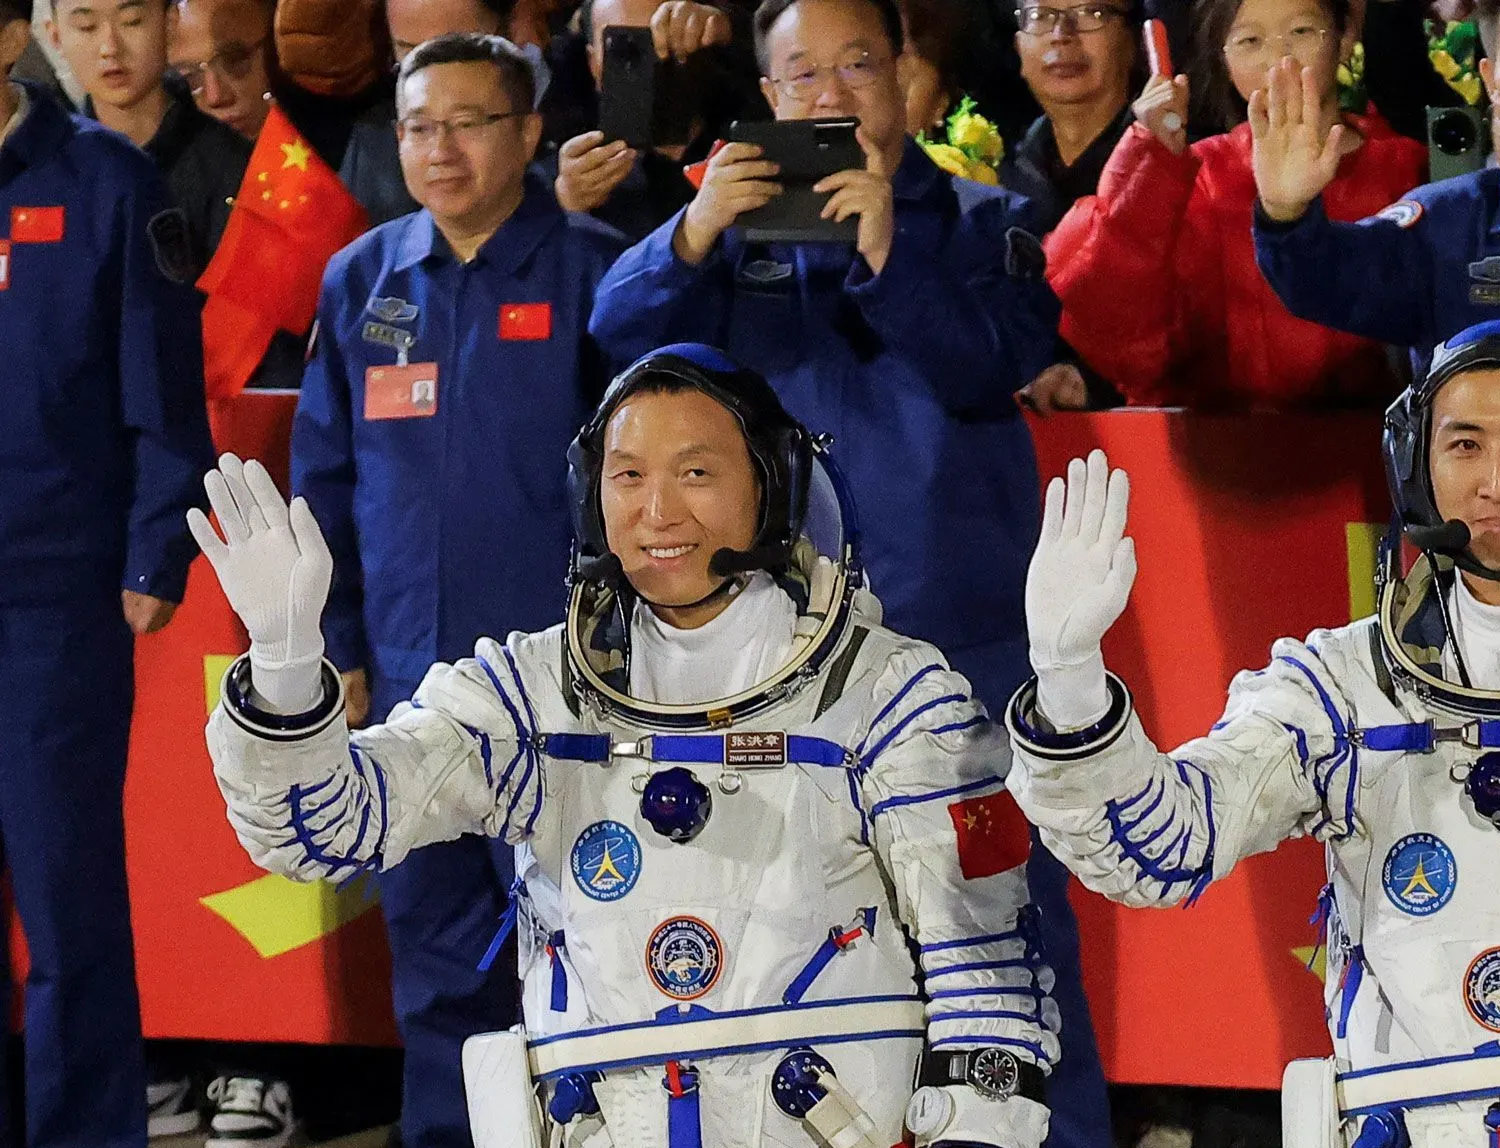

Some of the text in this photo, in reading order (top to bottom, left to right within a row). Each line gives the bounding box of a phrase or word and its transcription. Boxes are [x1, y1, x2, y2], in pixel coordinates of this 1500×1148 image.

[731, 734, 780, 747] 张洪章
[729, 754, 747, 763] ZHANG
[764, 754, 782, 762] ZHANG
